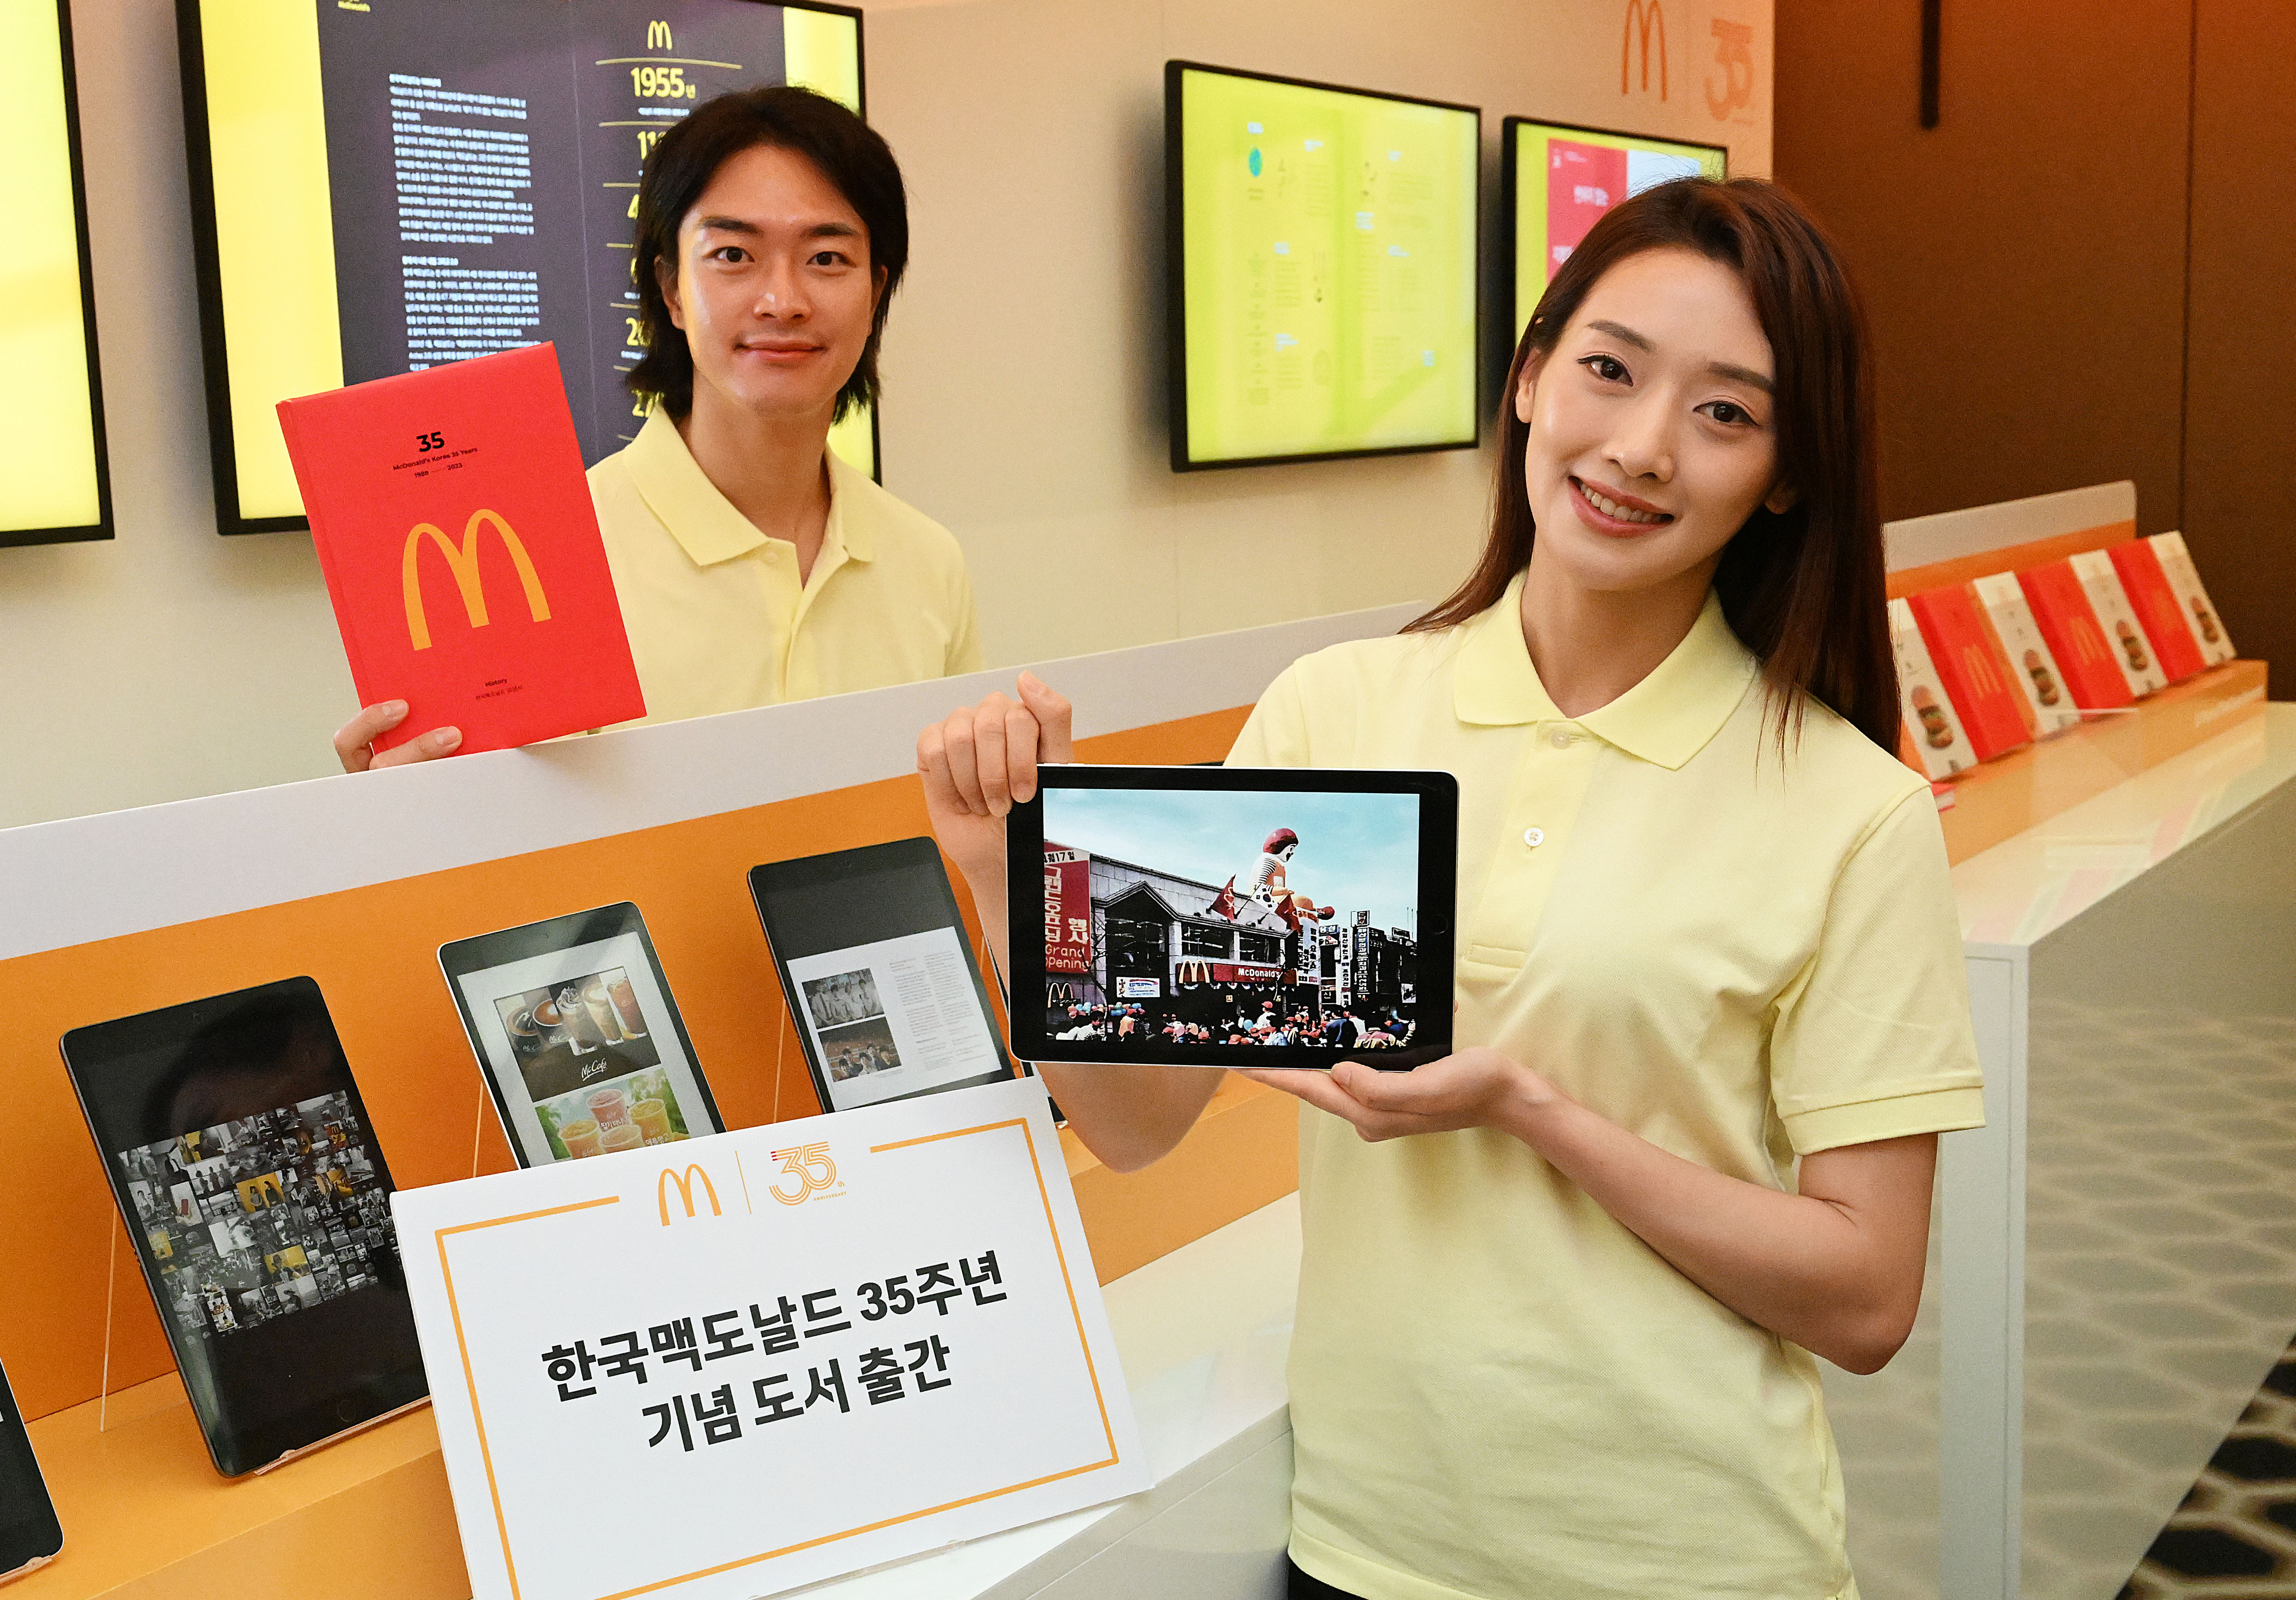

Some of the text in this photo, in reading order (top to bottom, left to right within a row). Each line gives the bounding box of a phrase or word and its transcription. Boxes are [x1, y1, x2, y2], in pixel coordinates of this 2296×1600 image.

[416, 431, 445, 452] 35
[393, 458, 430, 470] McDonald's
[432, 453, 450, 461] Korea
[460, 447, 478, 455] Years
[447, 463, 463, 471] 2023
[485, 678, 507, 687] History
[1045, 943, 1085, 958] Grand
[1238, 968, 1281, 978] McDonald's
[581, 1058, 607, 1080] McCafé
[600, 1121, 613, 1131] 딸기
[541, 1249, 1007, 1402] 한국맥도날드 35주년
[642, 1334, 952, 1452] 기념 도서 출간
